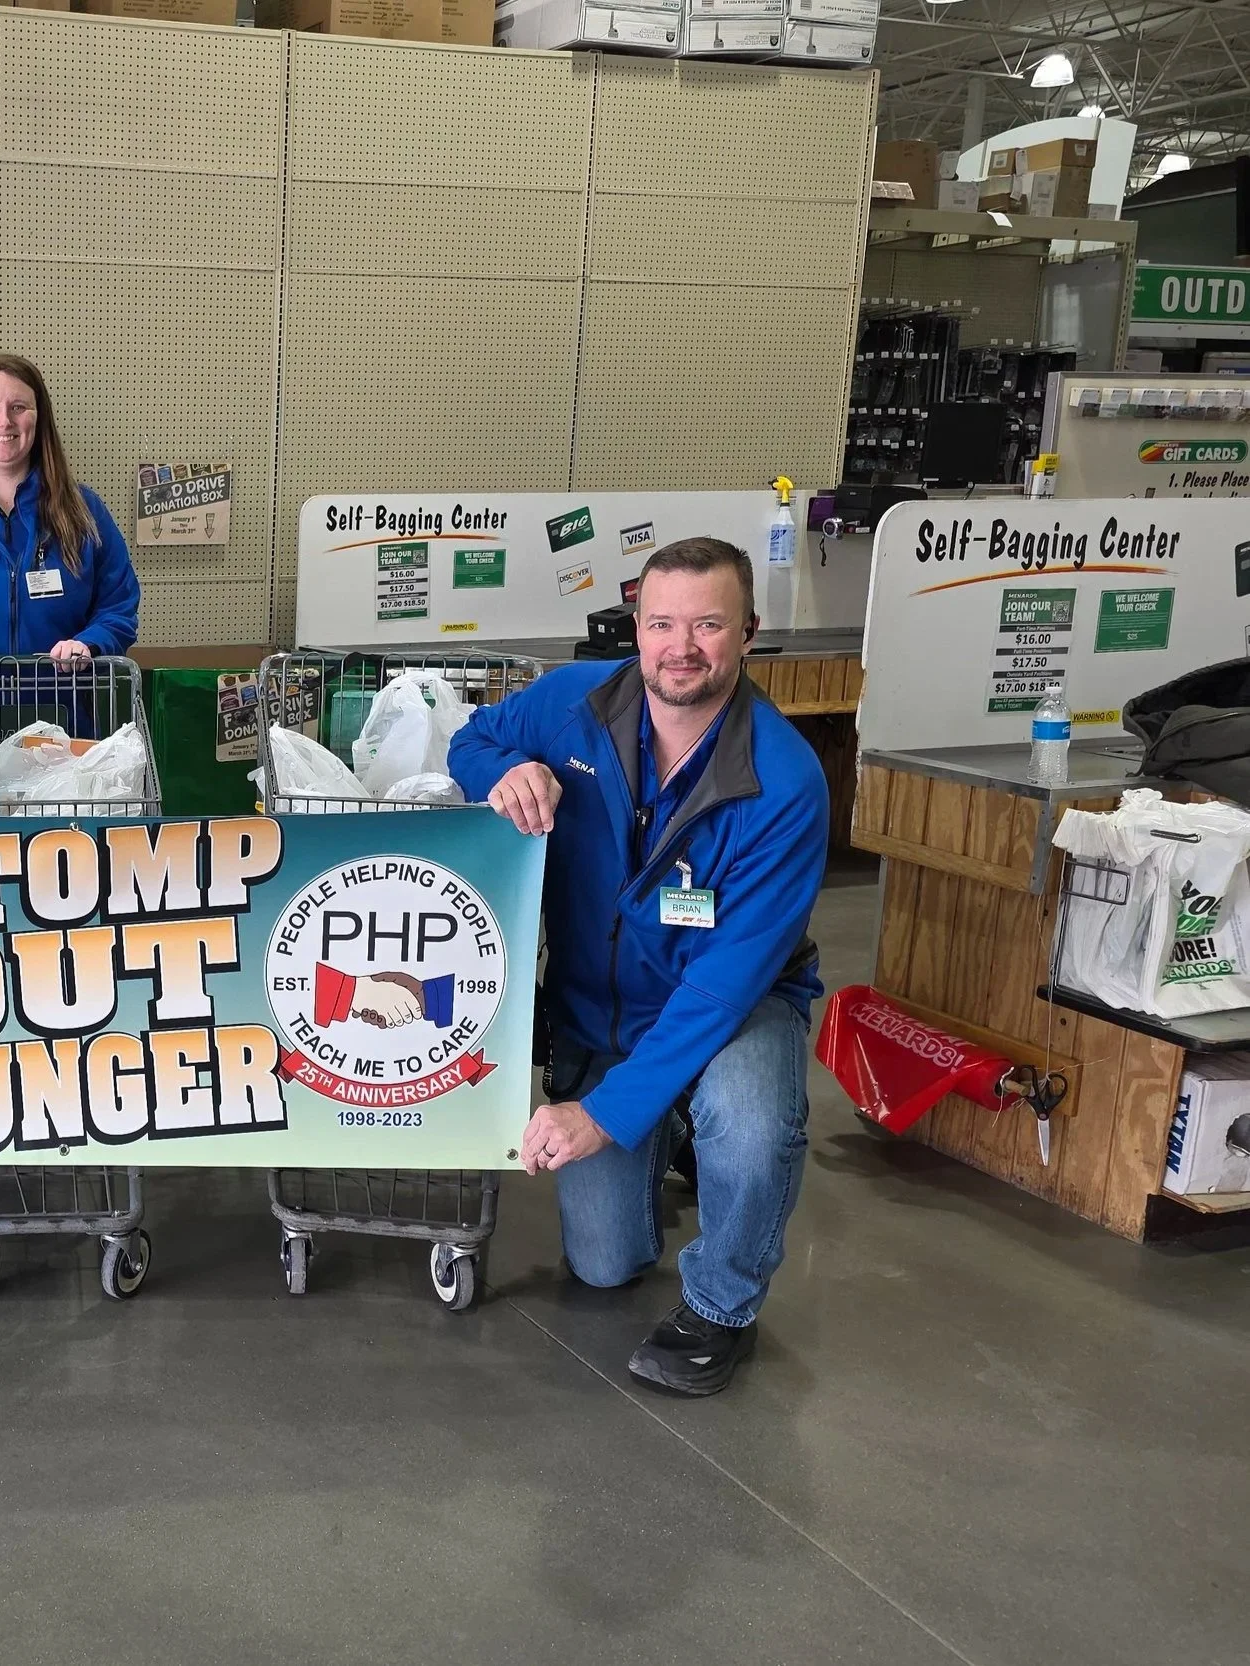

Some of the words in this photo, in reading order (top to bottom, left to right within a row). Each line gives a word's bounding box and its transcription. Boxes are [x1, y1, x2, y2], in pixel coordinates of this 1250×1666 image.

[1163, 447, 1191, 460] GIFT
[1195, 447, 1239, 460] CARDS
[185, 475, 225, 493] DRIVE
[1169, 473, 1178, 488] 1.
[1182, 471, 1217, 488] Please
[1220, 471, 1249, 488] Place
[144, 495, 199, 515] DONATION
[201, 490, 224, 503] BOX
[326, 504, 443, 536] Self-Bagging
[451, 504, 507, 530] Center
[559, 514, 589, 538] BIG
[625, 531, 651, 545] VISA
[916, 518, 1088, 570] Self-Bagging
[1100, 516, 1180, 560] Center
[390, 570, 415, 578] $16.00
[559, 568, 589, 584] DISCOVER
[389, 585, 415, 593] $17.50
[404, 599, 425, 607] $18.50
[1115, 594, 1127, 603] WE
[1127, 593, 1160, 602] WELCOME
[1005, 602, 1029, 611] JOIN
[1031, 601, 1051, 611] OUR
[1116, 603, 1133, 612] YOUR
[1134, 602, 1157, 611] CHECK
[1005, 612, 1036, 622] TEAM!
[1015, 633, 1051, 645] $16.00
[1012, 656, 1047, 669] $17.50
[995, 683, 1026, 694] $17.00
[1073, 712, 1105, 721] WARNING
[666, 893, 708, 902] MENARDS
[276, 880, 337, 956] PEOPLE
[341, 862, 436, 888] HELPING
[440, 881, 497, 958] PEOPLE
[672, 904, 701, 913] BRIAN
[321, 910, 458, 962] PHP
[273, 977, 311, 992] EST.
[457, 980, 497, 994] 1998
[288, 1012, 347, 1069] TEACH
[354, 1058, 385, 1077] ME
[394, 1056, 422, 1076] TO
[428, 1016, 479, 1064] CARE
[849, 1002, 966, 1073] MENARDS!
[333, 1064, 464, 1104] ANNIVERSARY
[337, 1111, 423, 1127] 1998-2023
[1166, 1094, 1191, 1174] TYTAN
